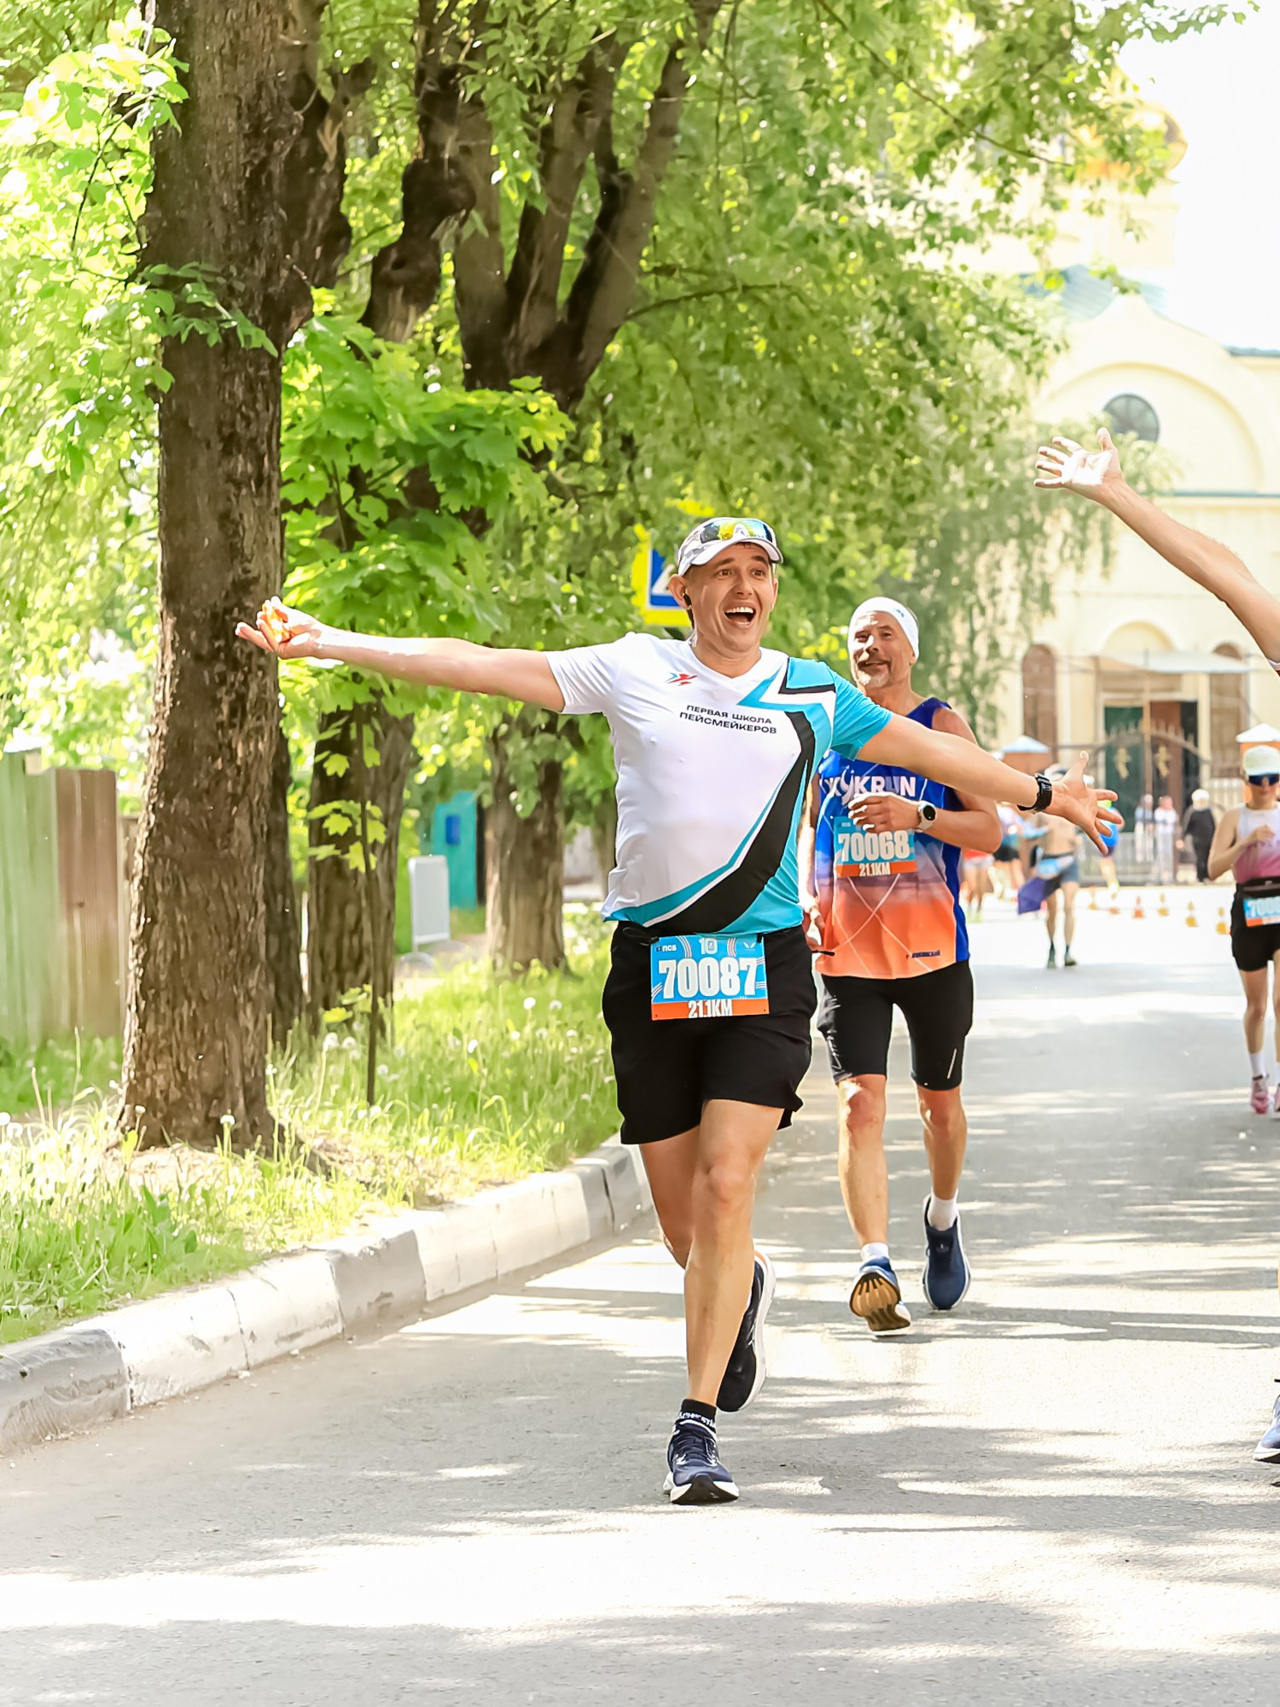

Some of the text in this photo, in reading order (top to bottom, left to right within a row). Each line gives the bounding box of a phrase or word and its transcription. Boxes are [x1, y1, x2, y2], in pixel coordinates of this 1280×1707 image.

[679, 711, 778, 735] ПЕЙСМЕЙКЕРОВ
[686, 704, 773, 725] ПЕРВАЯ ШКОЛА
[837, 830, 911, 862] 70068
[658, 957, 758, 999] 70087
[688, 999, 733, 1019] 21.1KM
